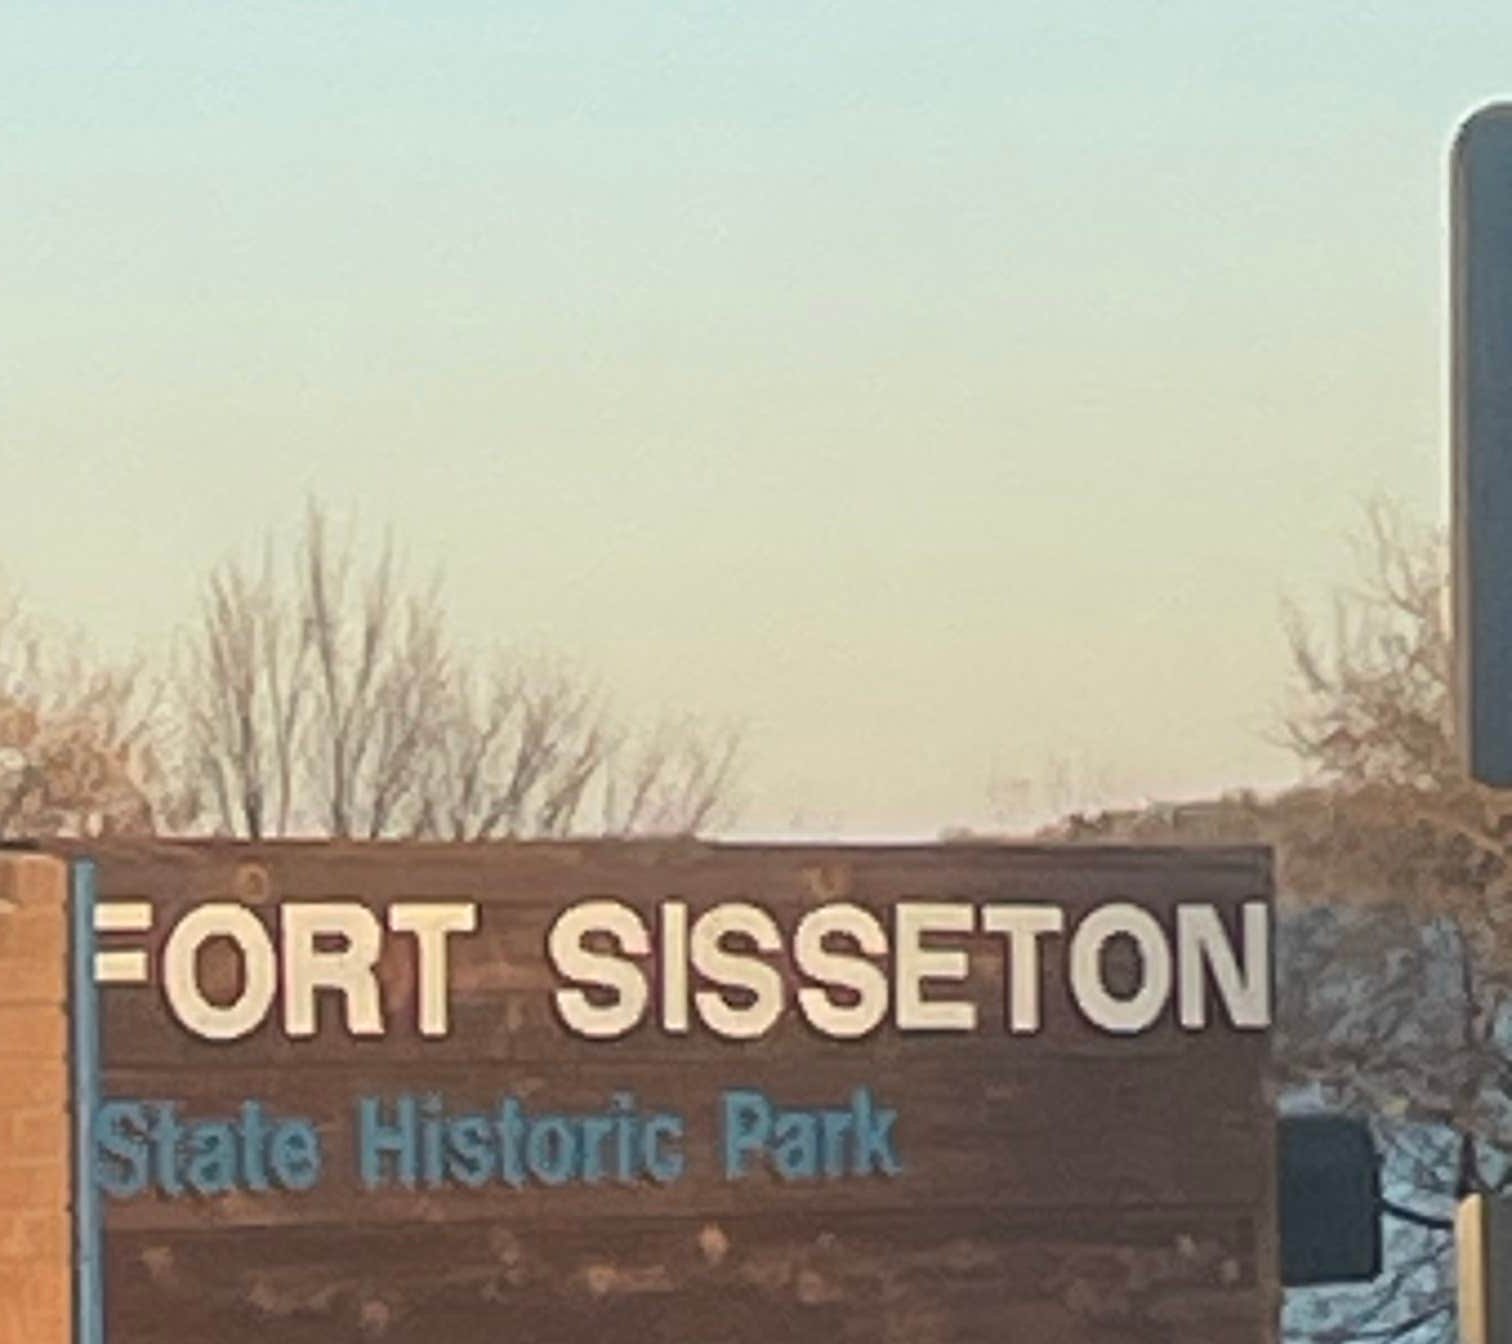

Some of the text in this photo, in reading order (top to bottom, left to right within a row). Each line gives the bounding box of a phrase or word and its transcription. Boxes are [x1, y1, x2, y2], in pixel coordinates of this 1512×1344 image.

[548, 902, 1272, 1038] SISSETON
[96, 1090, 900, 1196] State Historic Park
